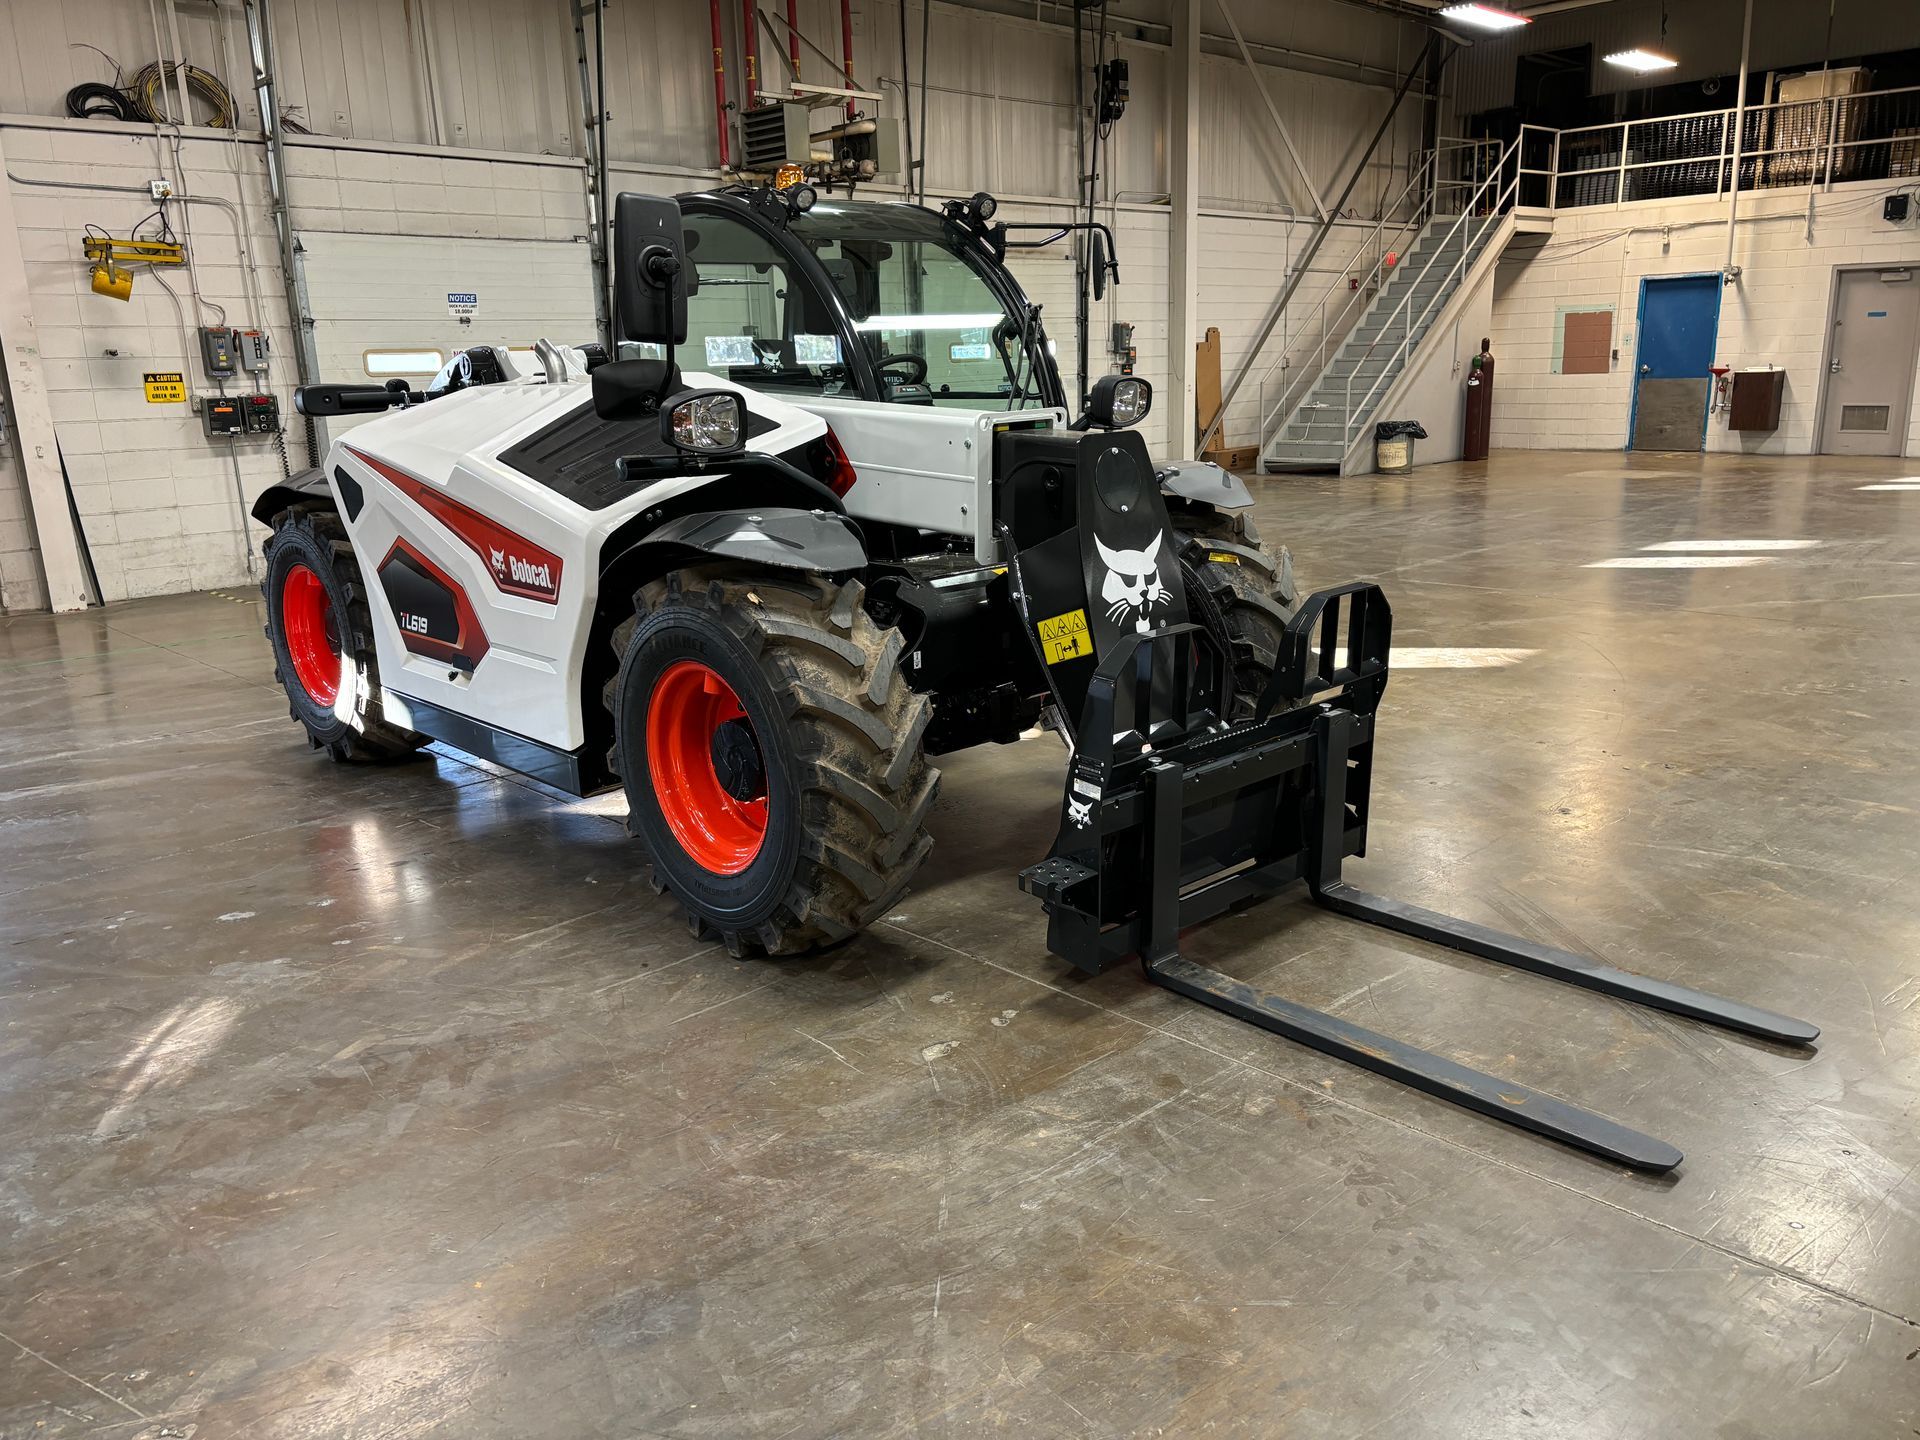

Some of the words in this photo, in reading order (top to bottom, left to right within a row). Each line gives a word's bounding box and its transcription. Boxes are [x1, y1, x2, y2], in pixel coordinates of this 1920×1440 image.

[156, 374, 180, 382] CAUTION
[508, 555, 552, 589] Bobcat
[400, 611, 428, 634] TL619
